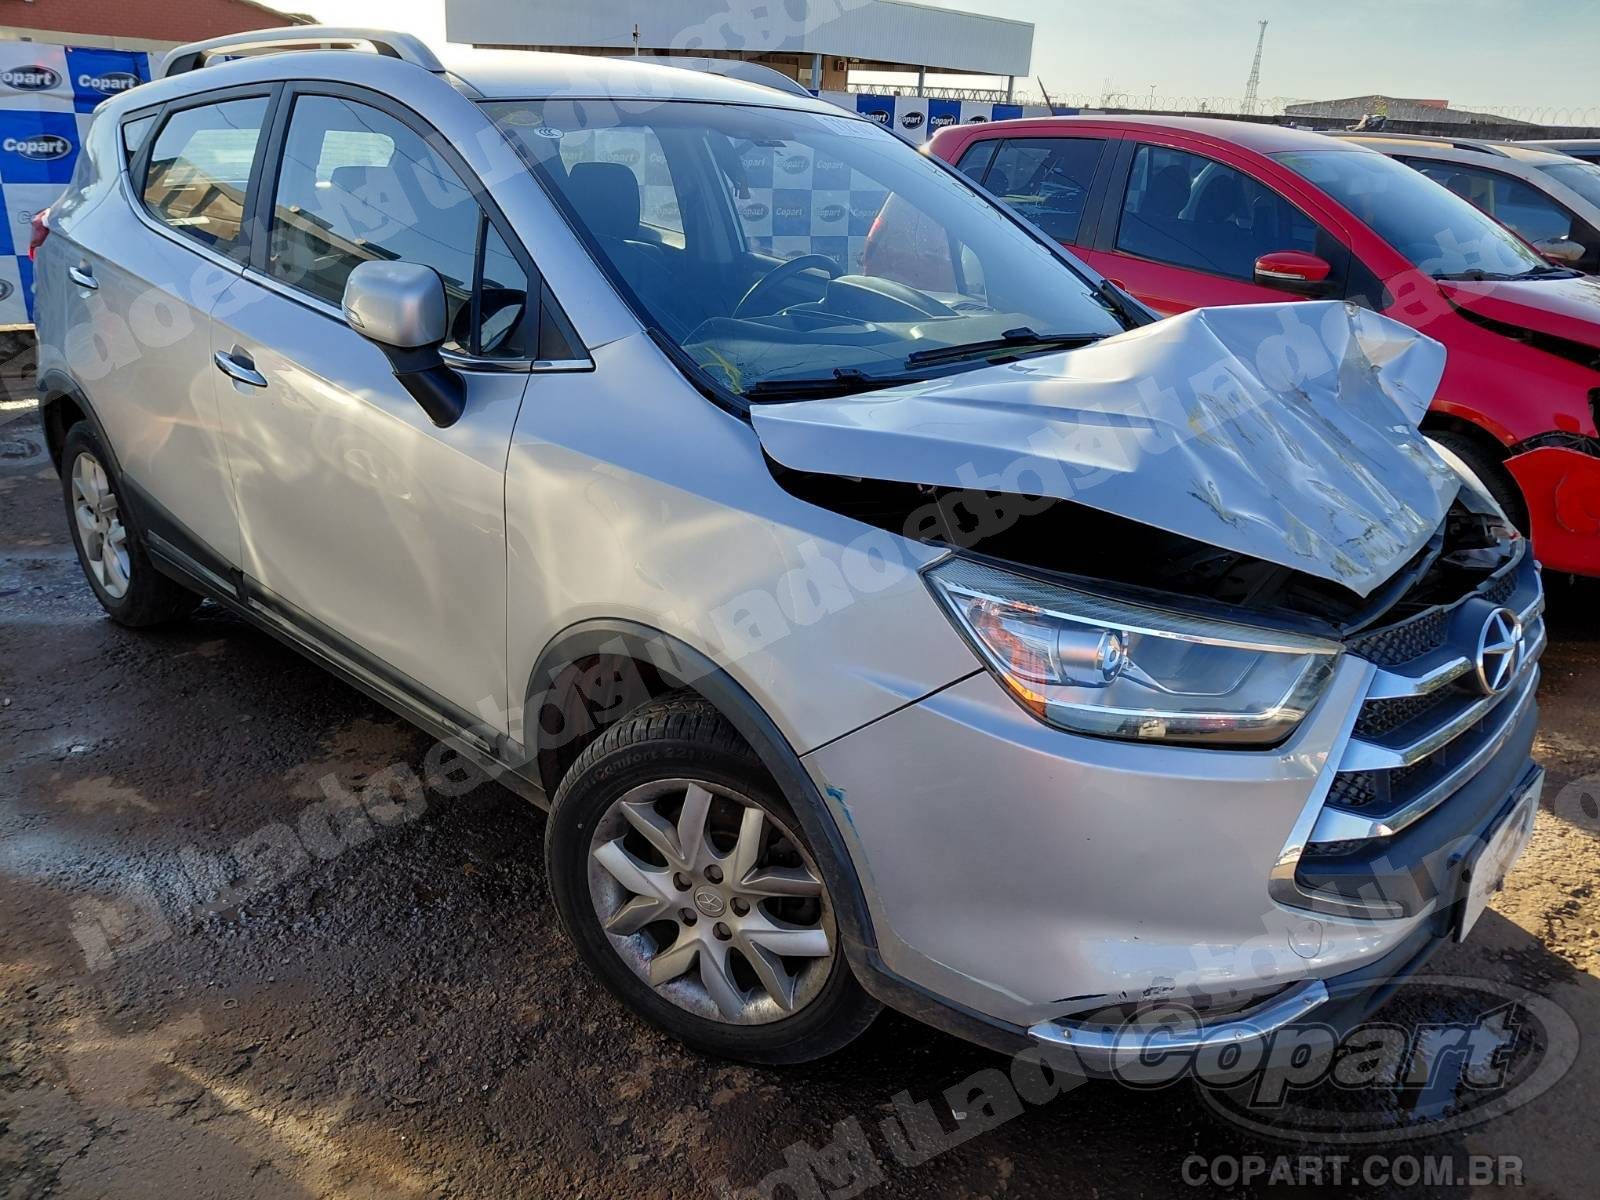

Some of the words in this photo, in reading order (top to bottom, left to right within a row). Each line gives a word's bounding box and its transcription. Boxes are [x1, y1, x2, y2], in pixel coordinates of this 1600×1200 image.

[0, 71, 52, 86] opart
[78, 74, 136, 90] Copart
[930, 116, 954, 126] Copart
[3, 138, 64, 155] Copart
[742, 157, 766, 169] opart
[776, 207, 802, 218] Copart
